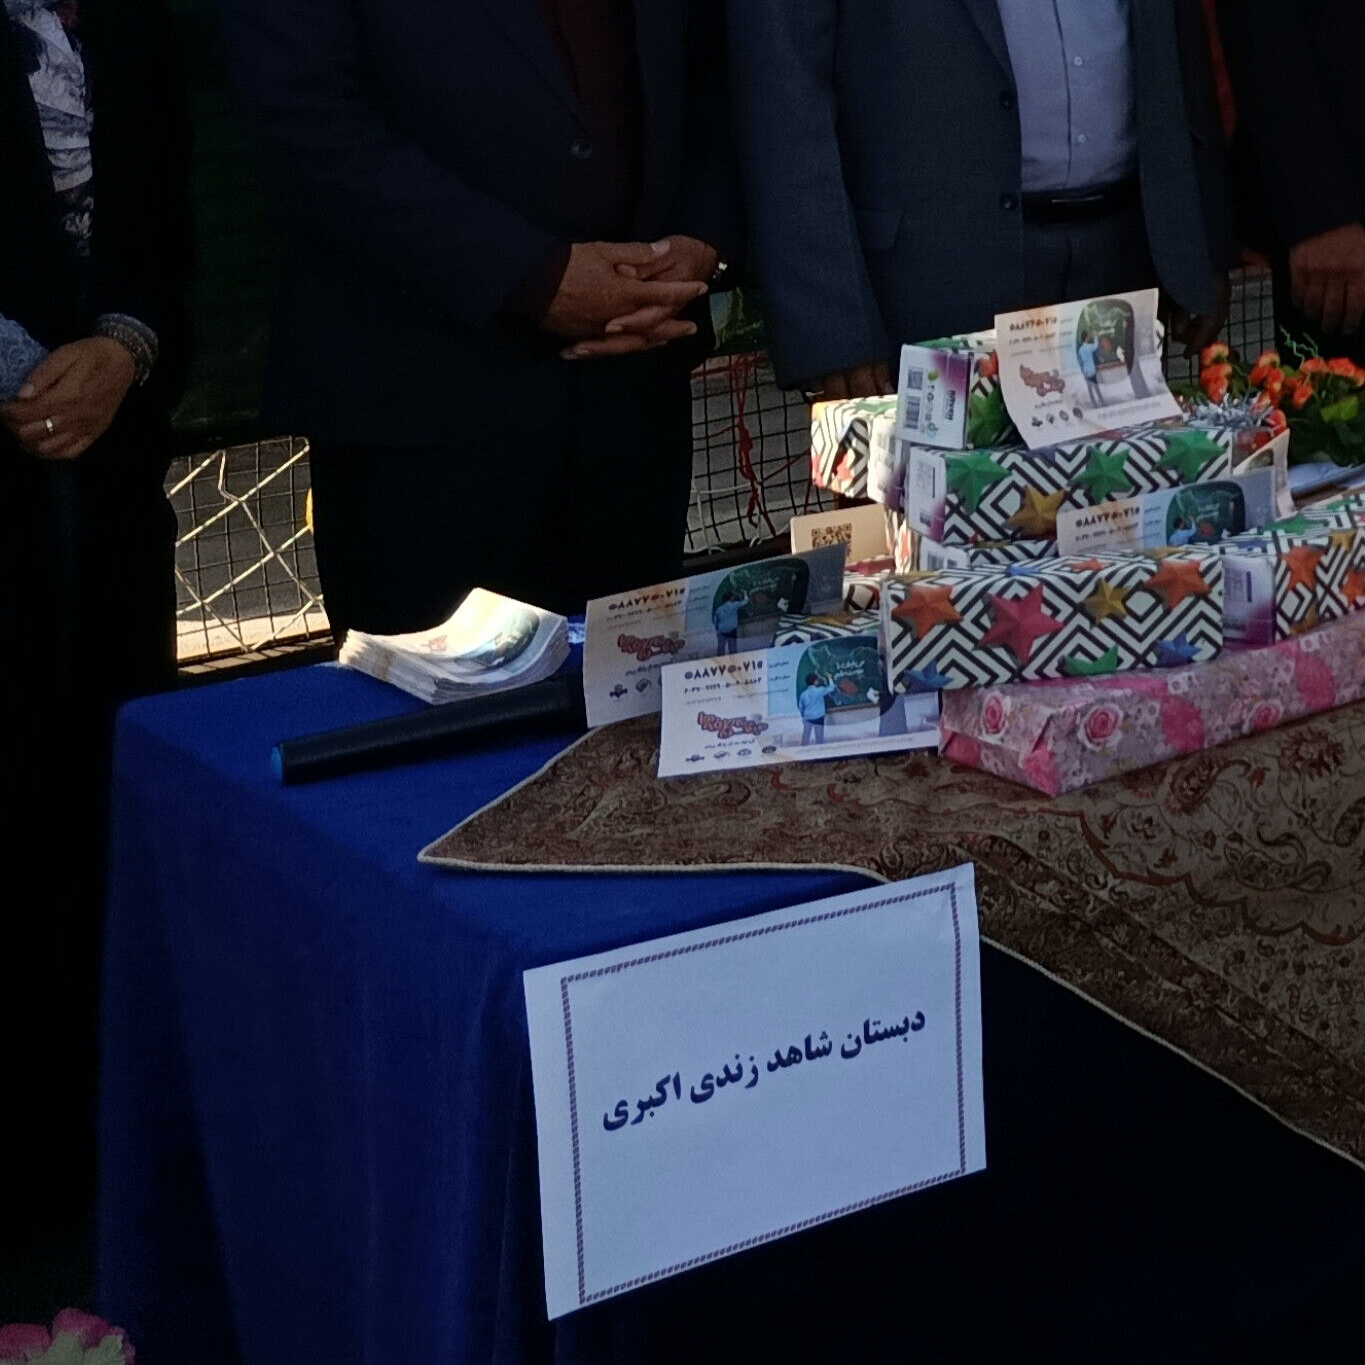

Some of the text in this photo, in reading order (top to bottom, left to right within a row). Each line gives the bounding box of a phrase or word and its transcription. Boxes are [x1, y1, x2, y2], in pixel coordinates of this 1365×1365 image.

[603, 1010, 926, 1132] دبستان شاهد زندی اکبری
